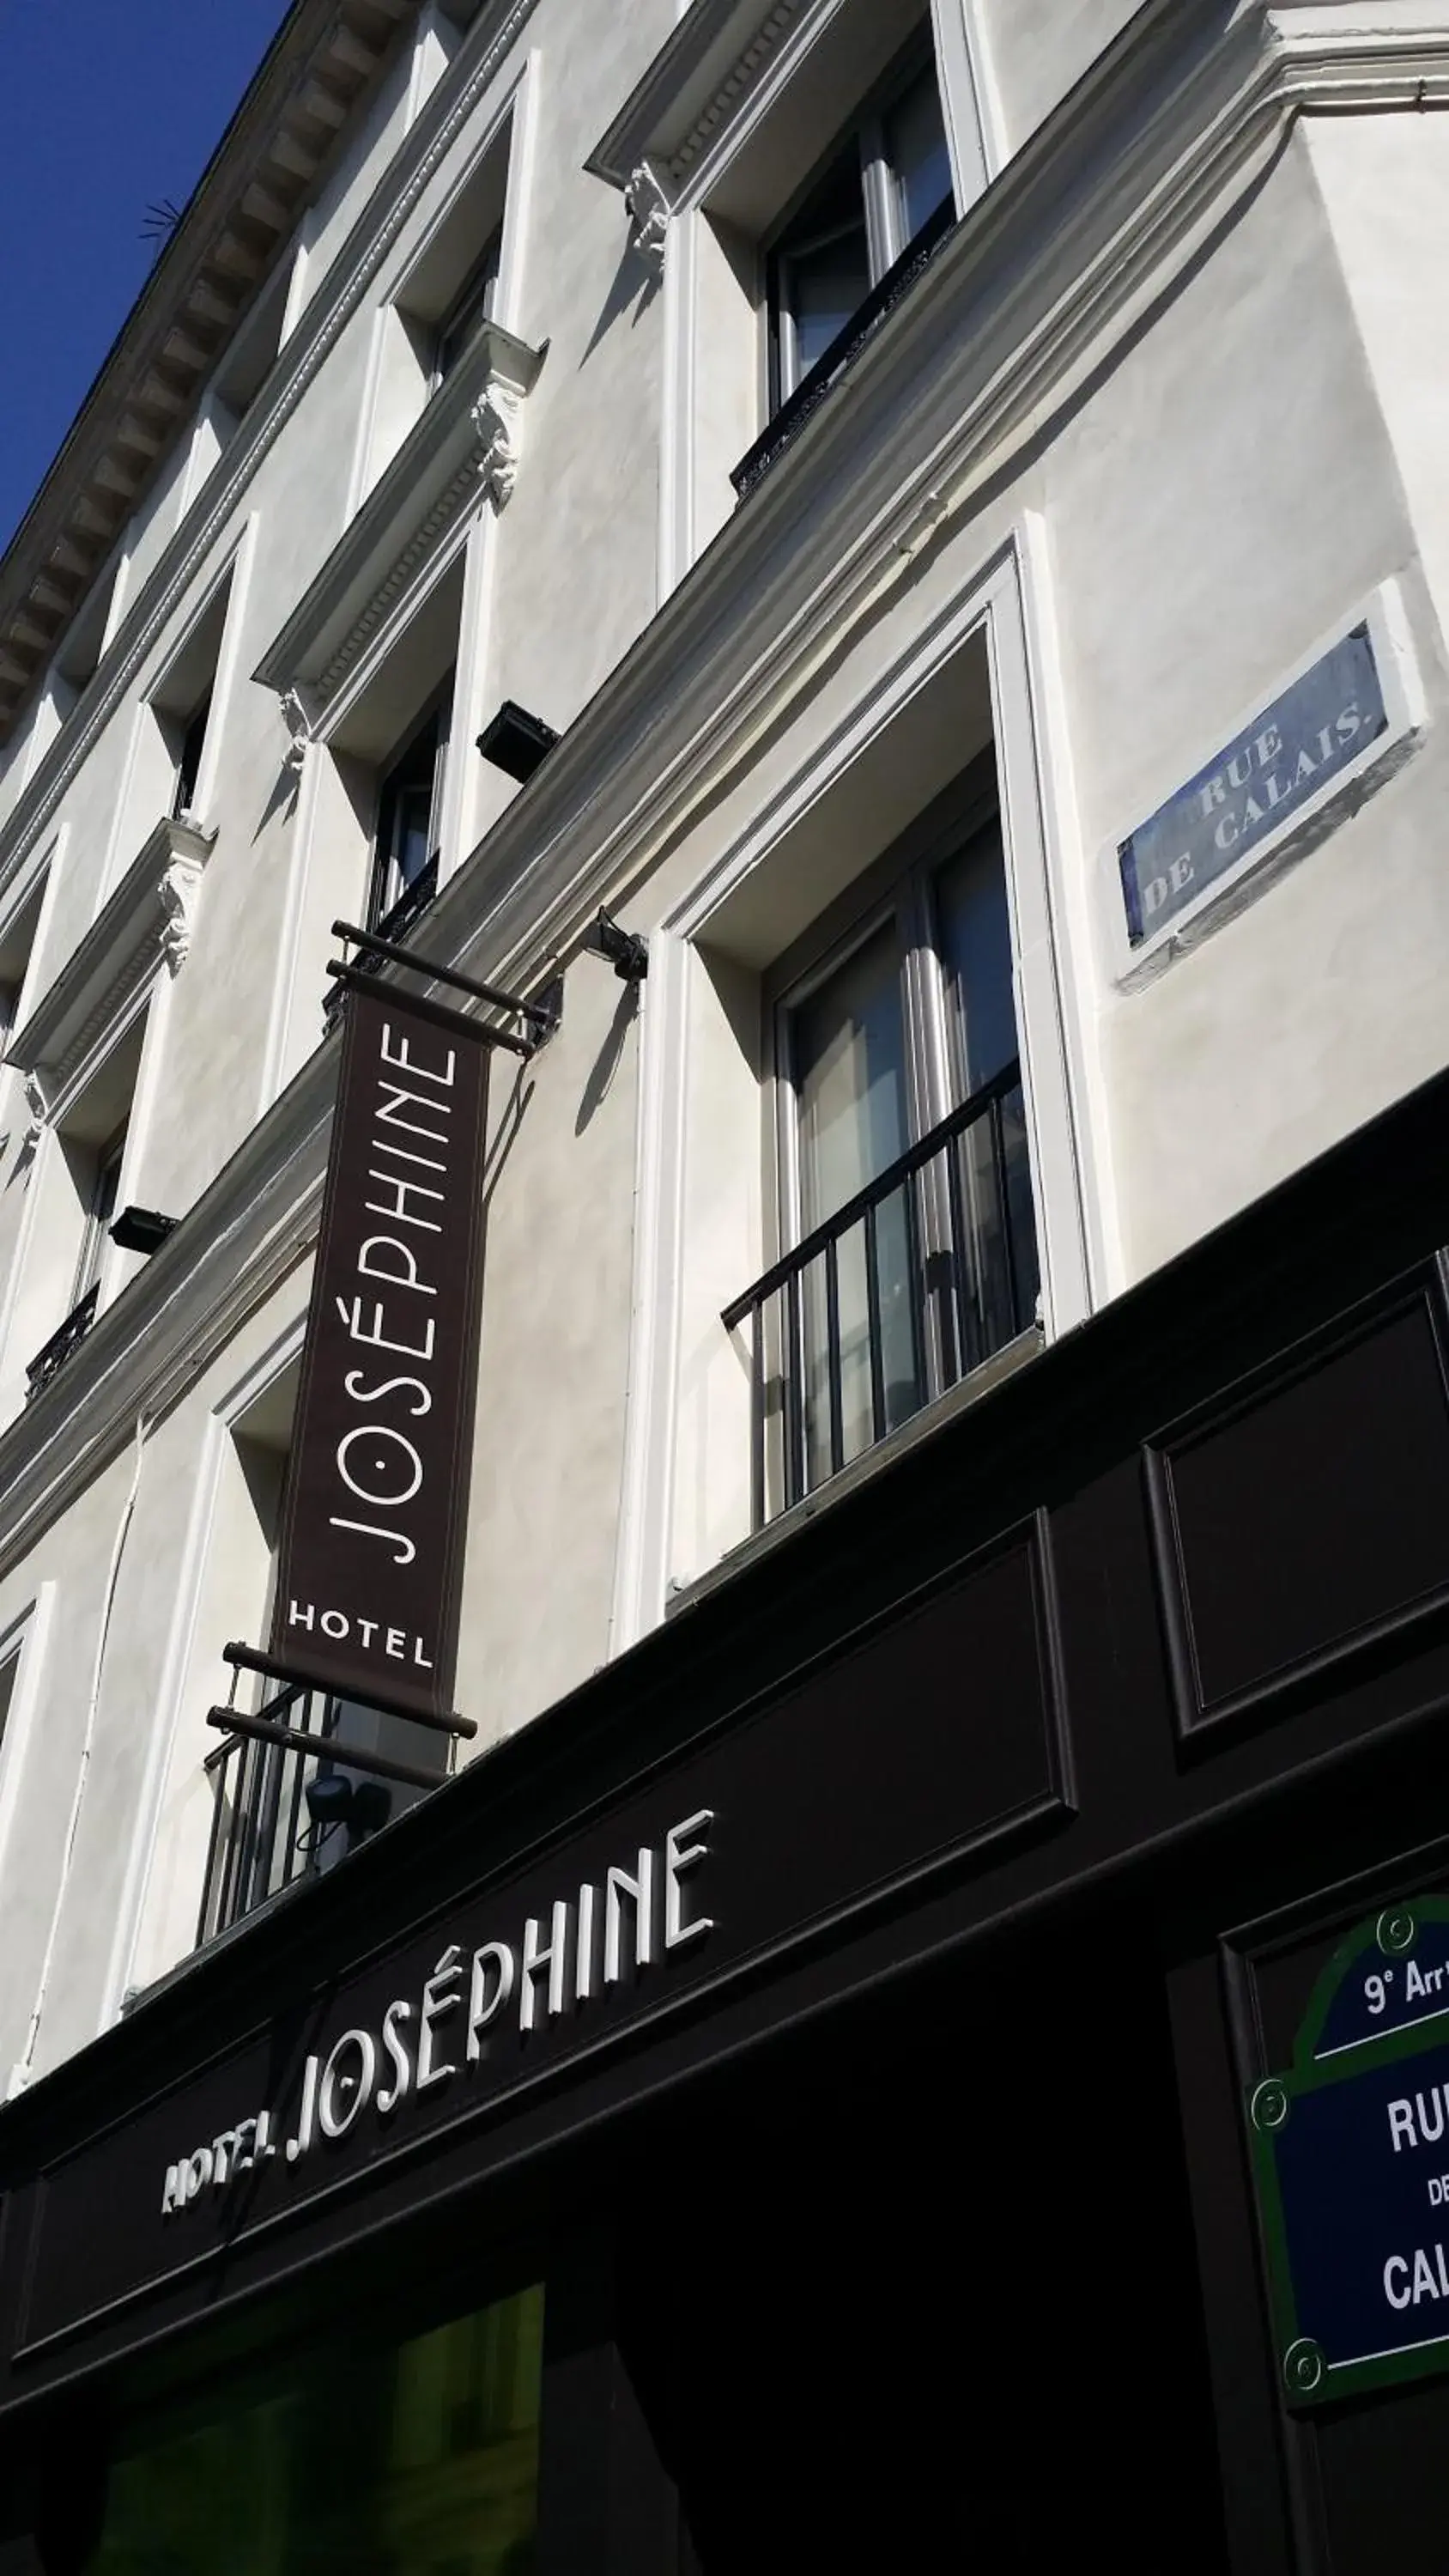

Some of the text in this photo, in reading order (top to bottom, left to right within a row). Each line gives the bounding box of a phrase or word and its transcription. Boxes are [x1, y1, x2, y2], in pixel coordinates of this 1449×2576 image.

[1143, 703, 1372, 915] DE CALAIS.
[1202, 725, 1282, 816] RUE
[330, 1023, 457, 1565] JOSÉPHINE
[288, 1600, 434, 1669] HOTEL
[161, 1809, 716, 2214] HOTEL JOSÉPHINE
